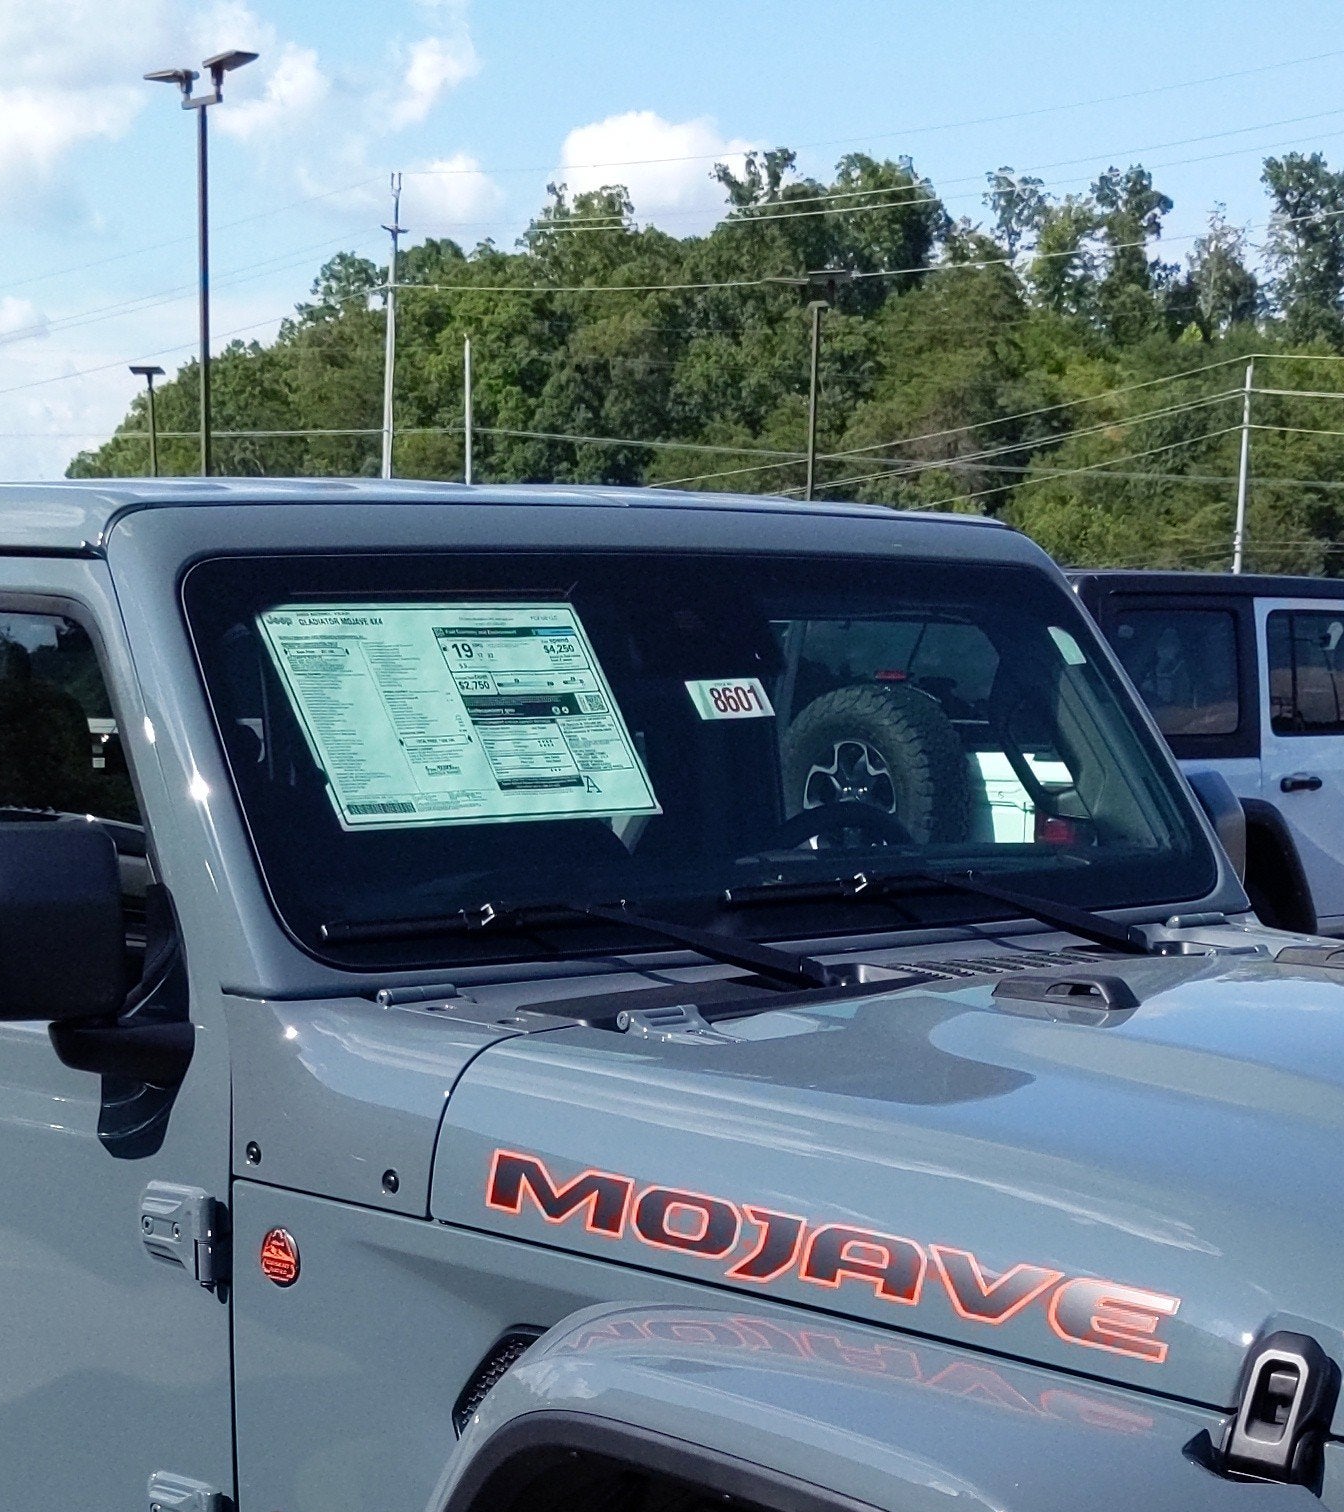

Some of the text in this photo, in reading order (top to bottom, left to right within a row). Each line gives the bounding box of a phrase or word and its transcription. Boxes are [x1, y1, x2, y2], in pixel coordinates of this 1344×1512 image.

[266, 614, 293, 626] Jeep
[298, 618, 340, 626] GLADIATOR
[341, 618, 369, 626] MOJAVE
[451, 643, 473, 659] 19
[543, 644, 574, 655] $4,250
[458, 681, 490, 691] $2,750
[709, 685, 764, 712] 8601
[486, 1148, 1182, 1362] MOJAVE
